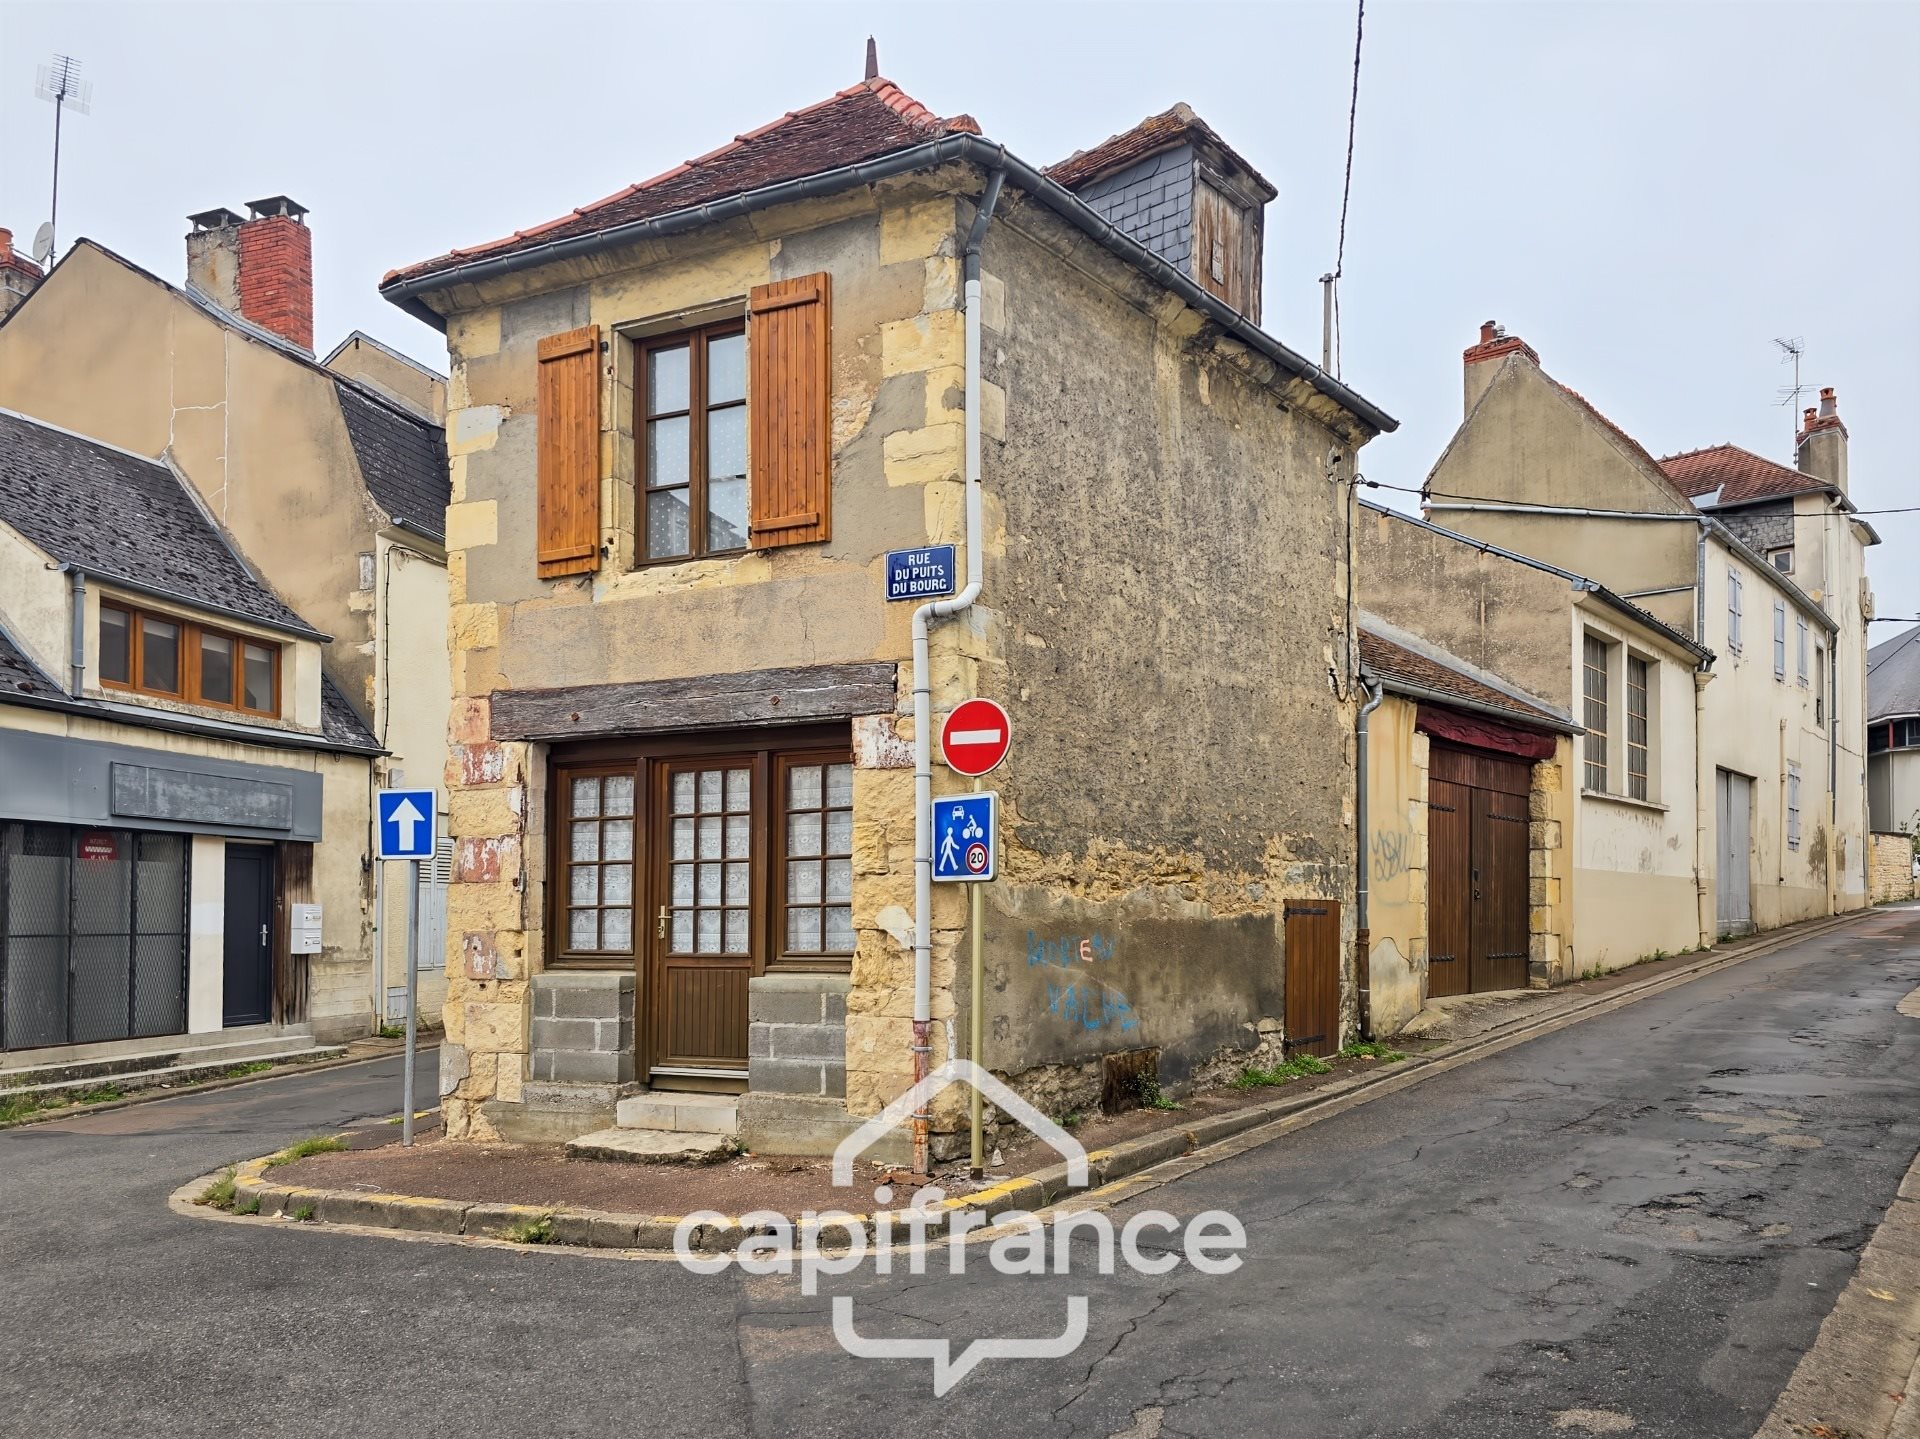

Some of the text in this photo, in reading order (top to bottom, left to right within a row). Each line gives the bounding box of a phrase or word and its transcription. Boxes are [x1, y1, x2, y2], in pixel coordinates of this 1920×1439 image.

[908, 552, 931, 566] RUE
[895, 565, 945, 581] DU PUITS
[892, 578, 947, 595] DU BOURG
[970, 852, 984, 864] 20
